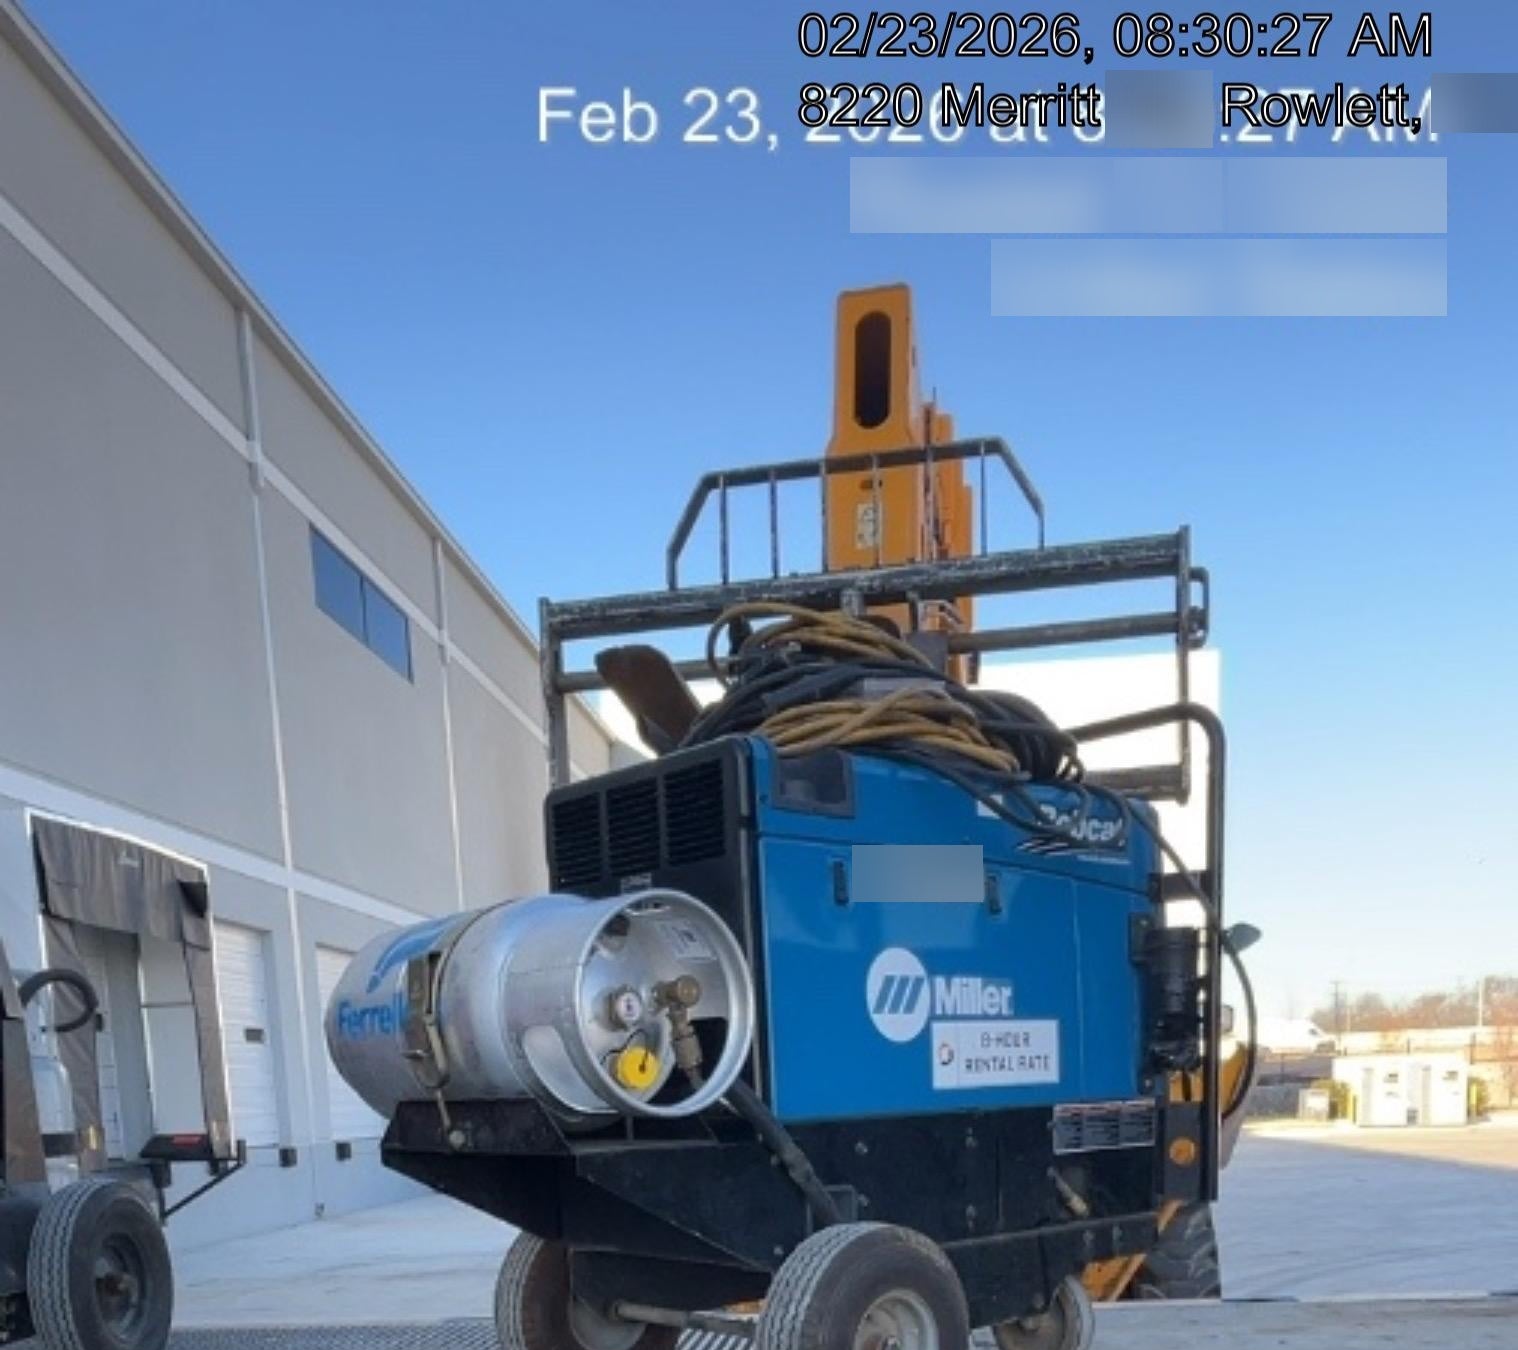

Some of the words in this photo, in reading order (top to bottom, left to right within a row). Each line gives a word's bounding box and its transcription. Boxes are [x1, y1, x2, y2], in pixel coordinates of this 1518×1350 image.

[934, 975, 1014, 1016] Miller
[964, 1054, 1014, 1074] RENTAL
[1018, 1054, 1049, 1071] RATE
